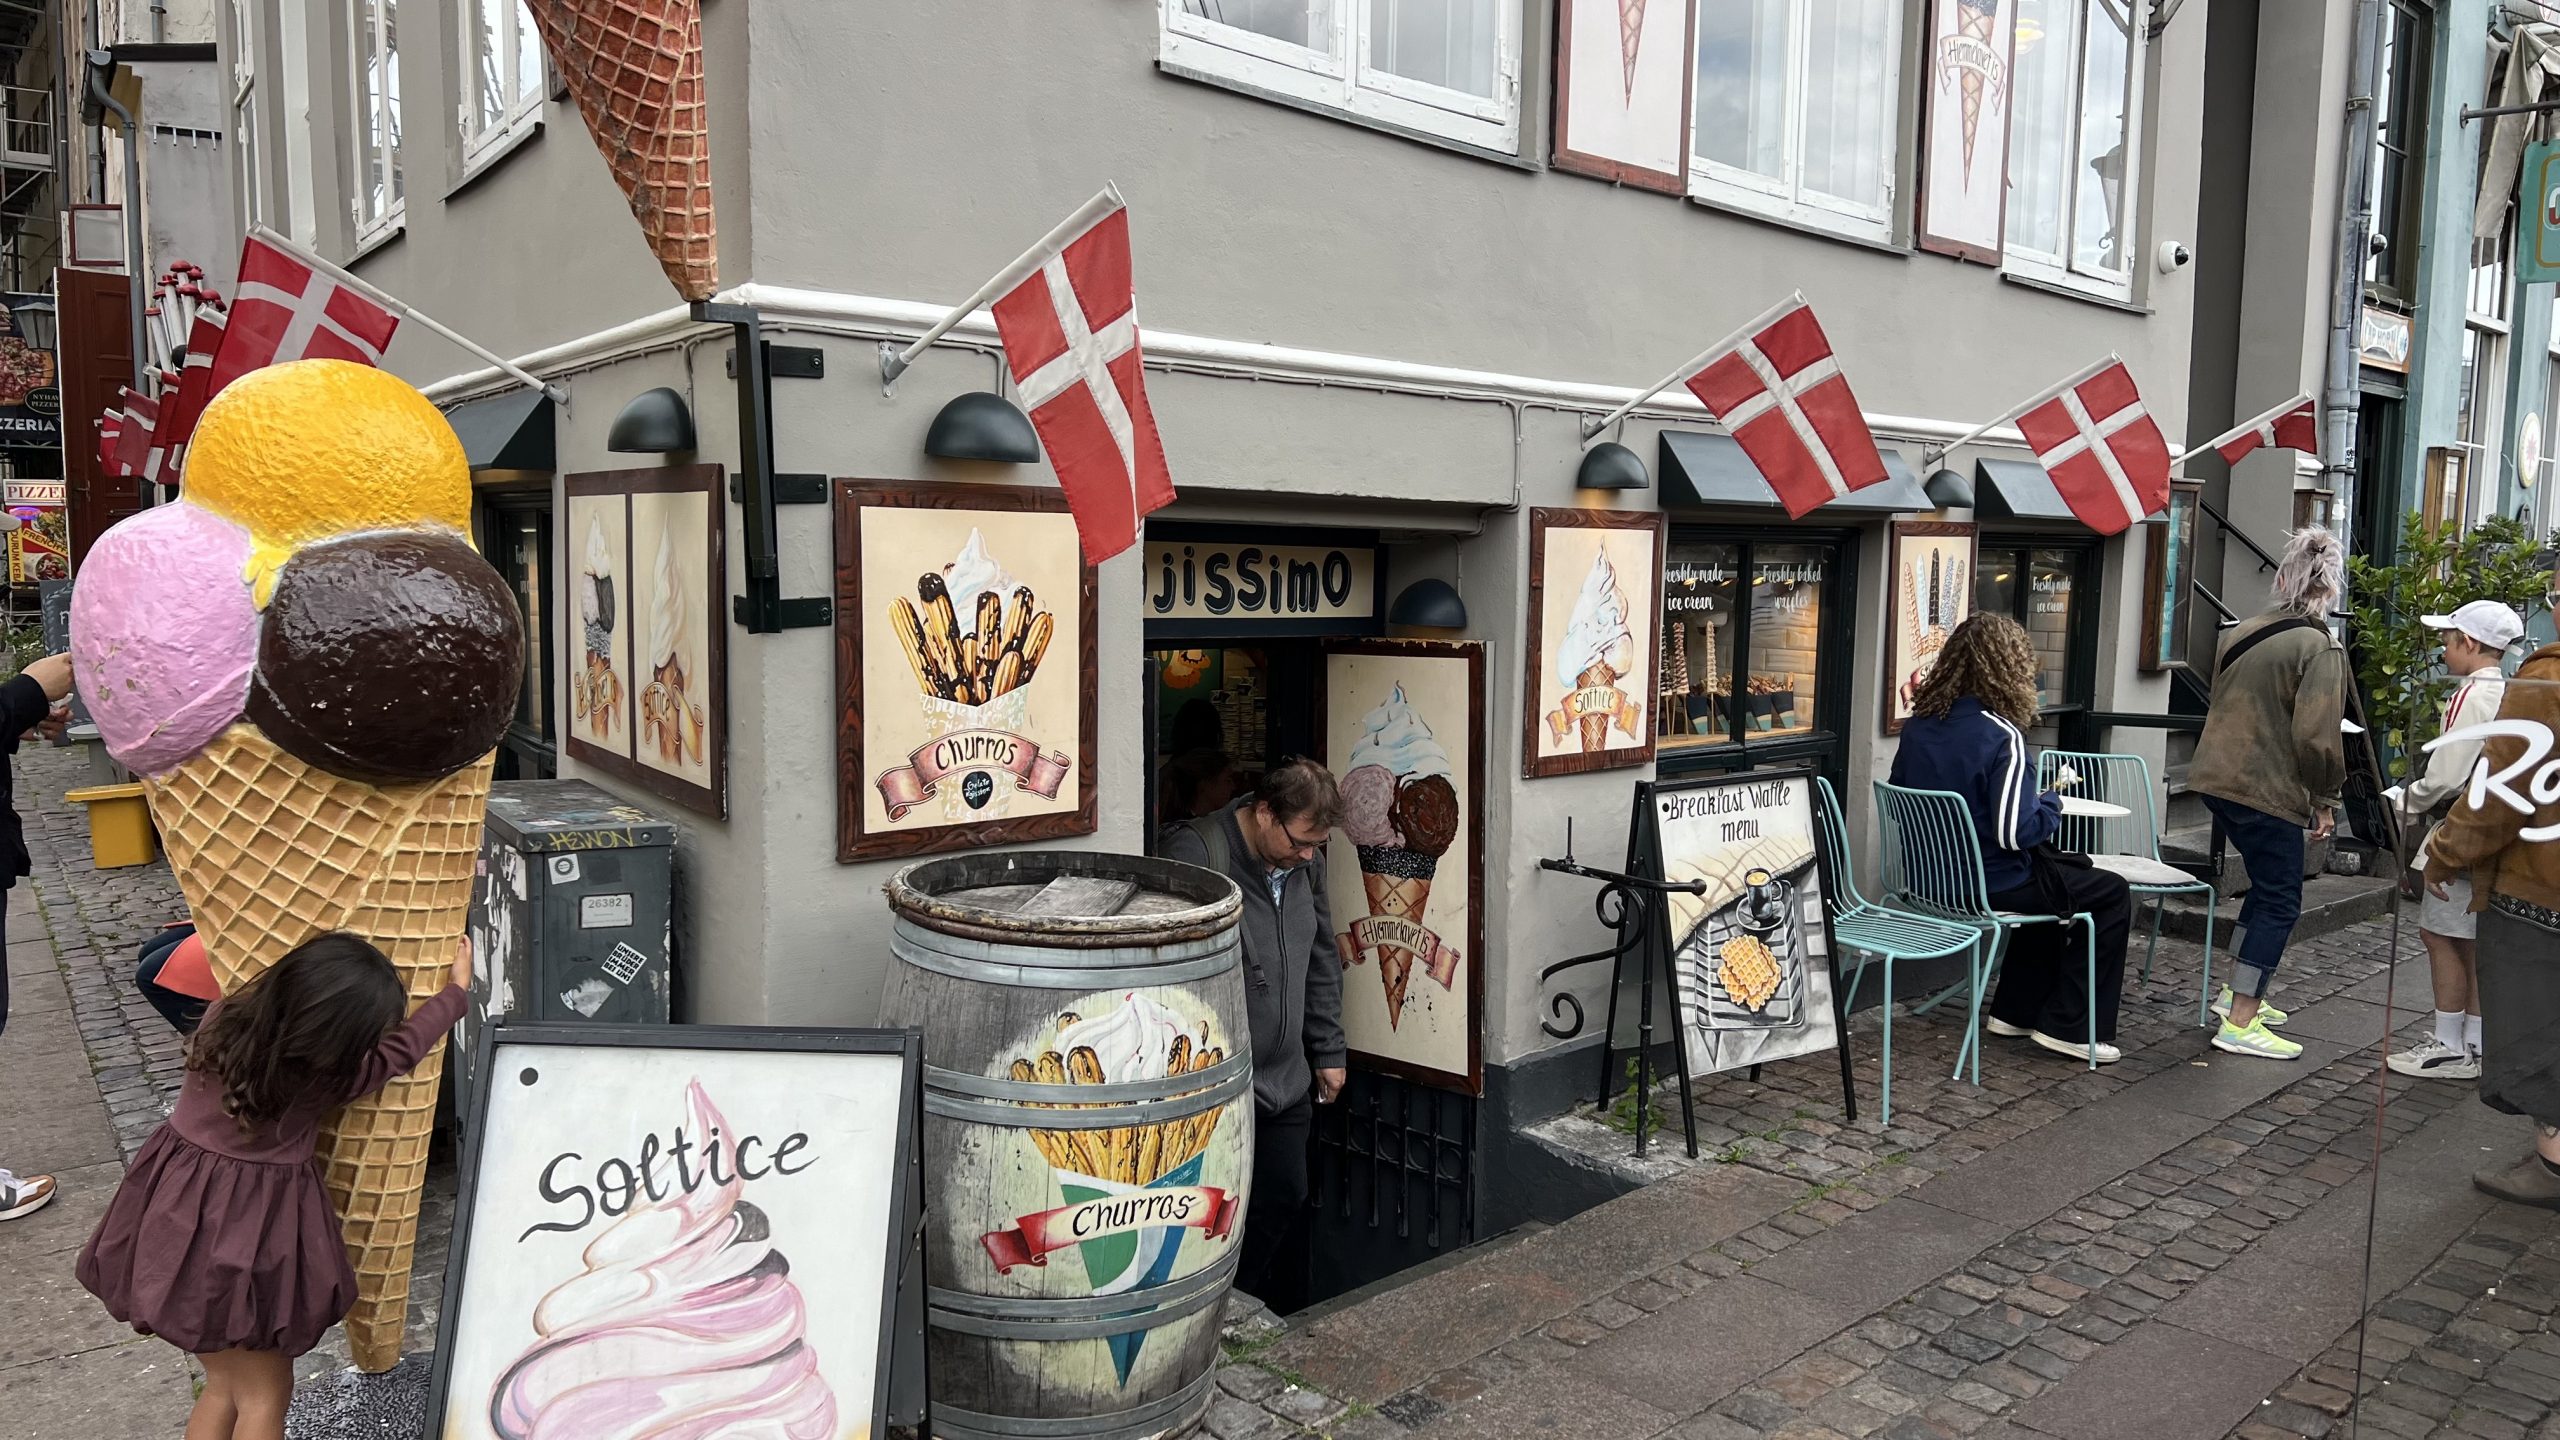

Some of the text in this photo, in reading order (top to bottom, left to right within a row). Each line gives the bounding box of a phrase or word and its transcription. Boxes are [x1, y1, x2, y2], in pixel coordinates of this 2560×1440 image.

[1143, 545, 1352, 615] jissimo
[1665, 562, 1724, 591] reshly made
[1762, 564, 1823, 591] Freshly baked
[1667, 592, 1714, 611] ice cream
[1574, 688, 1614, 714] Softice
[935, 736, 1018, 771] Churros
[1664, 780, 1791, 824] Breakfast Waffle
[1720, 818, 1760, 843] menu
[588, 897, 622, 909] 26382
[1361, 919, 1430, 955] Hjemmelavet is
[607, 956, 636, 976] IMMER
[617, 944, 645, 965] UNSERE
[603, 961, 631, 982] BEI UNS
[1072, 1194, 1197, 1237] Churros
